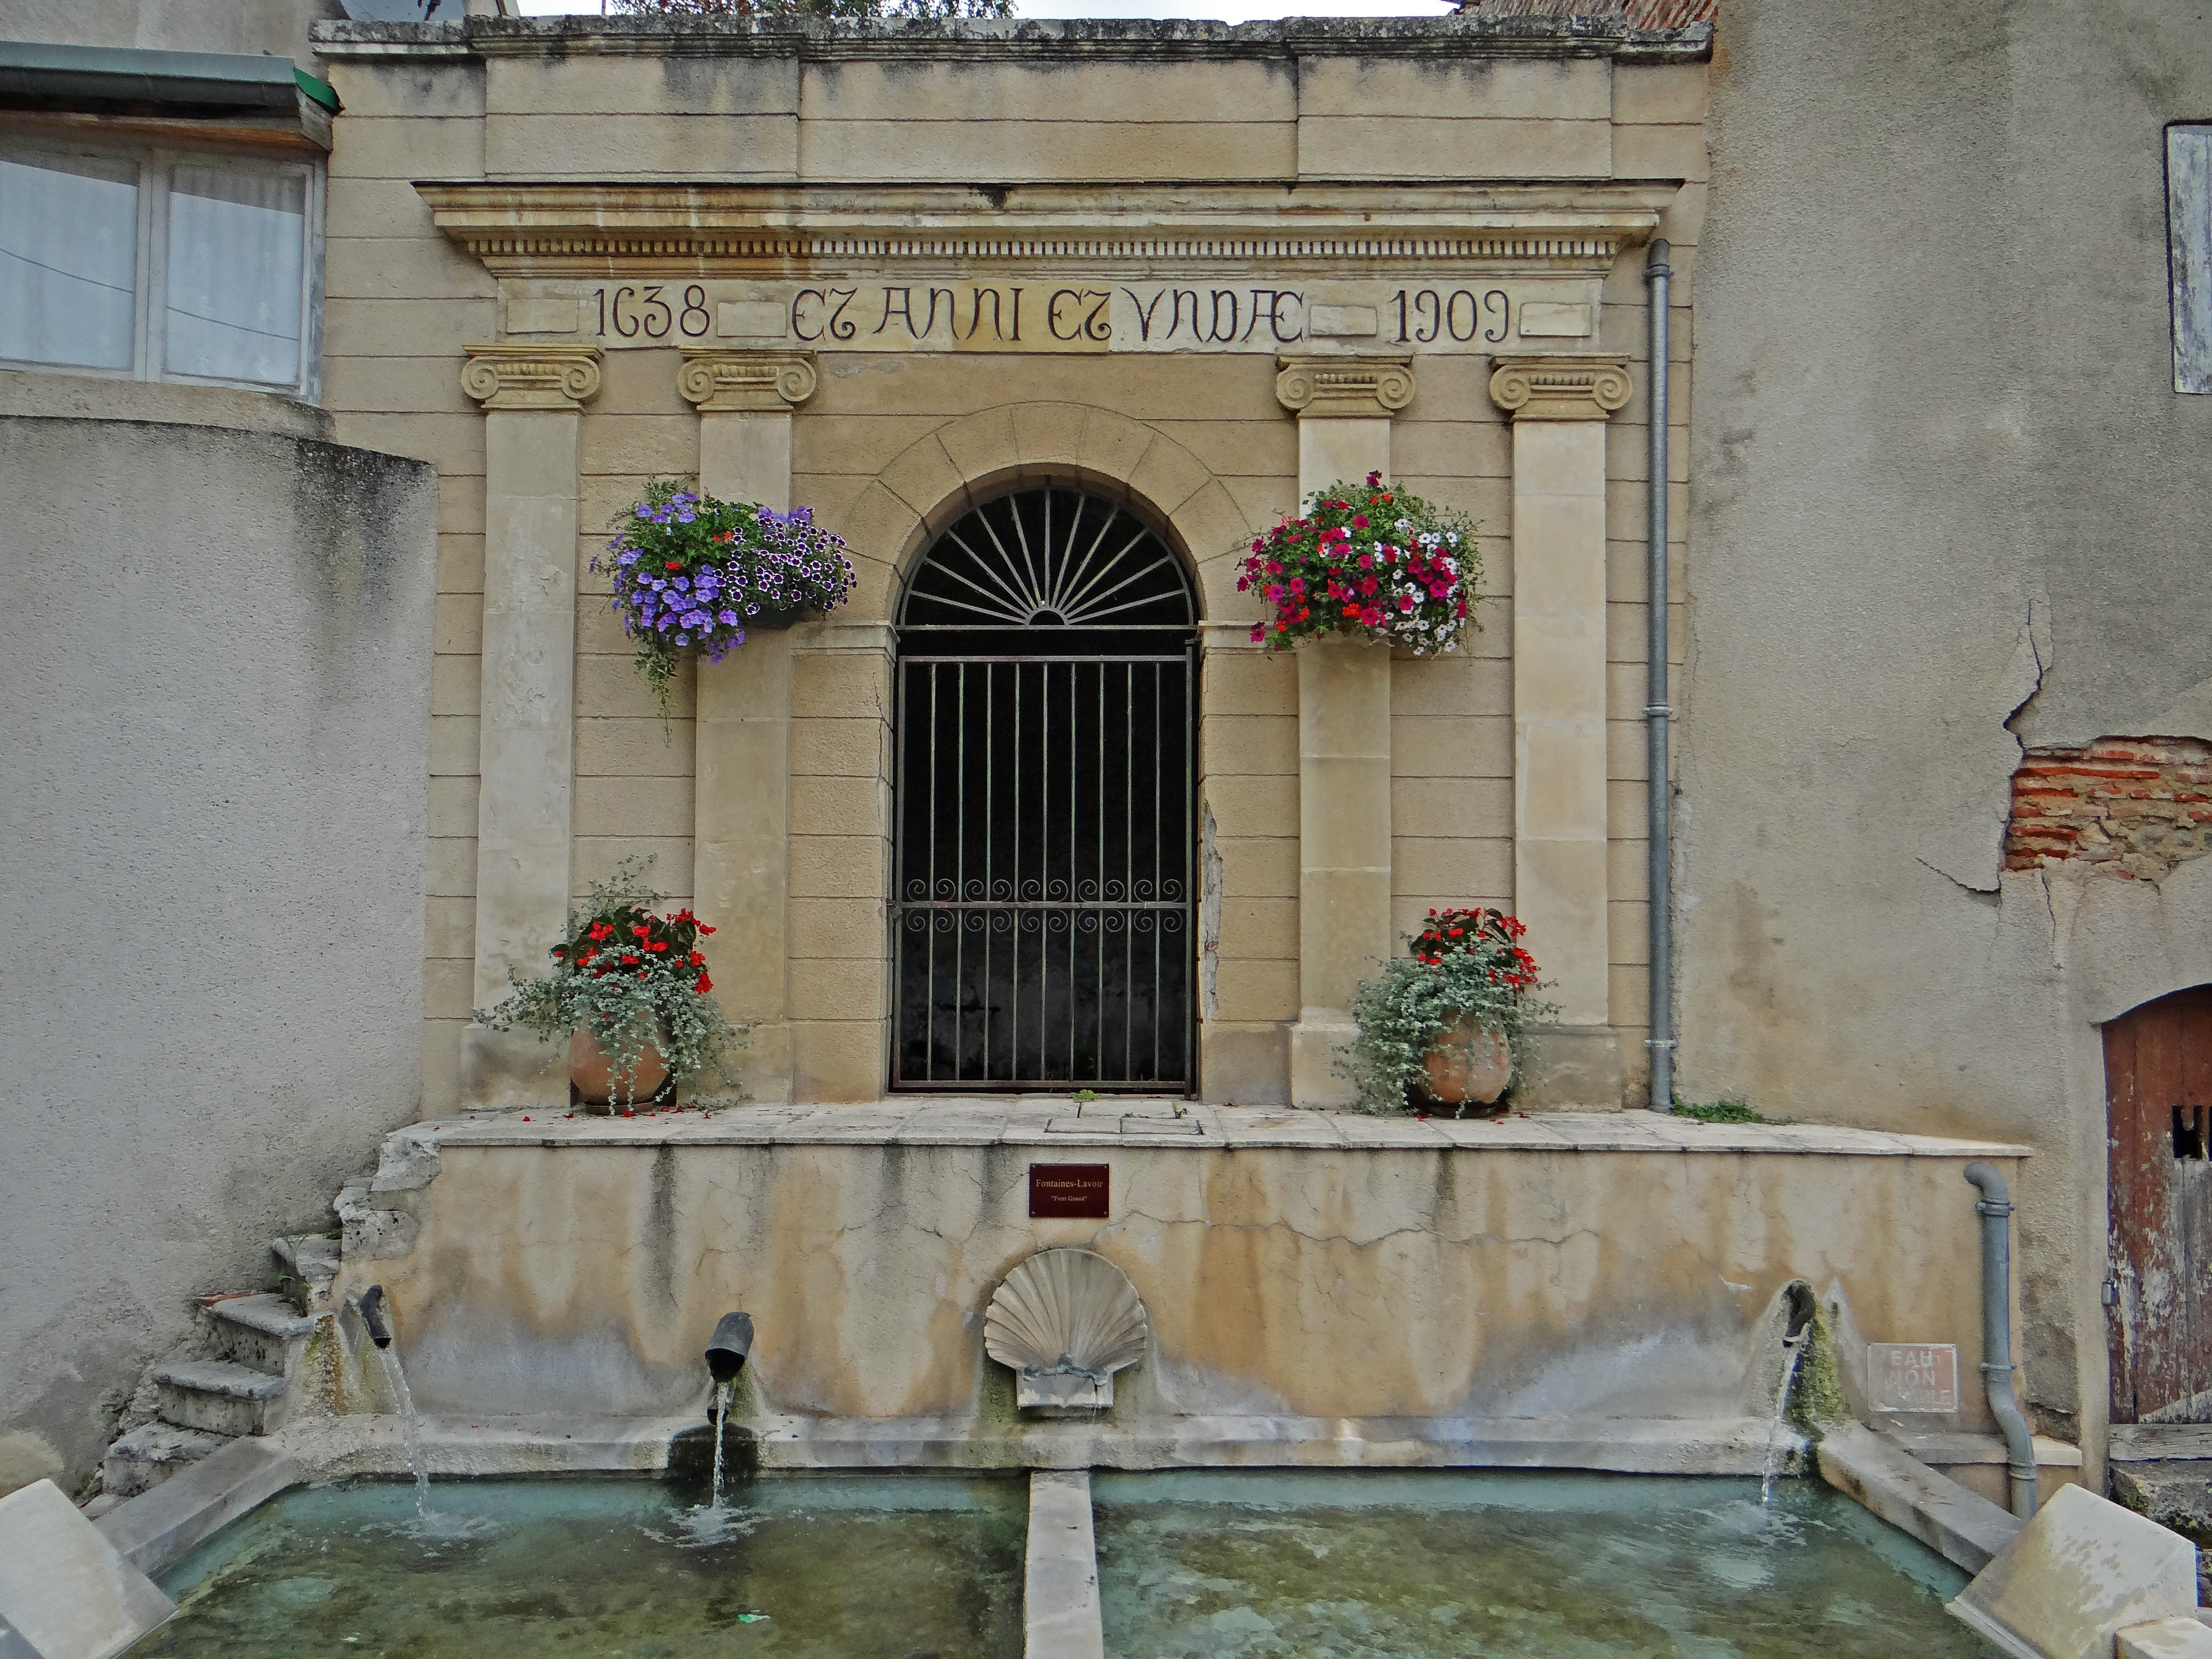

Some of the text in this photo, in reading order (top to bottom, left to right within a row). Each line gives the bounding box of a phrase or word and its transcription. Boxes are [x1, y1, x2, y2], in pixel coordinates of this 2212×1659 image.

[593, 284, 711, 339] 1638
[1388, 290, 1510, 343] 1909
[1036, 1179, 1103, 1188] Fontaines-Lavoir
